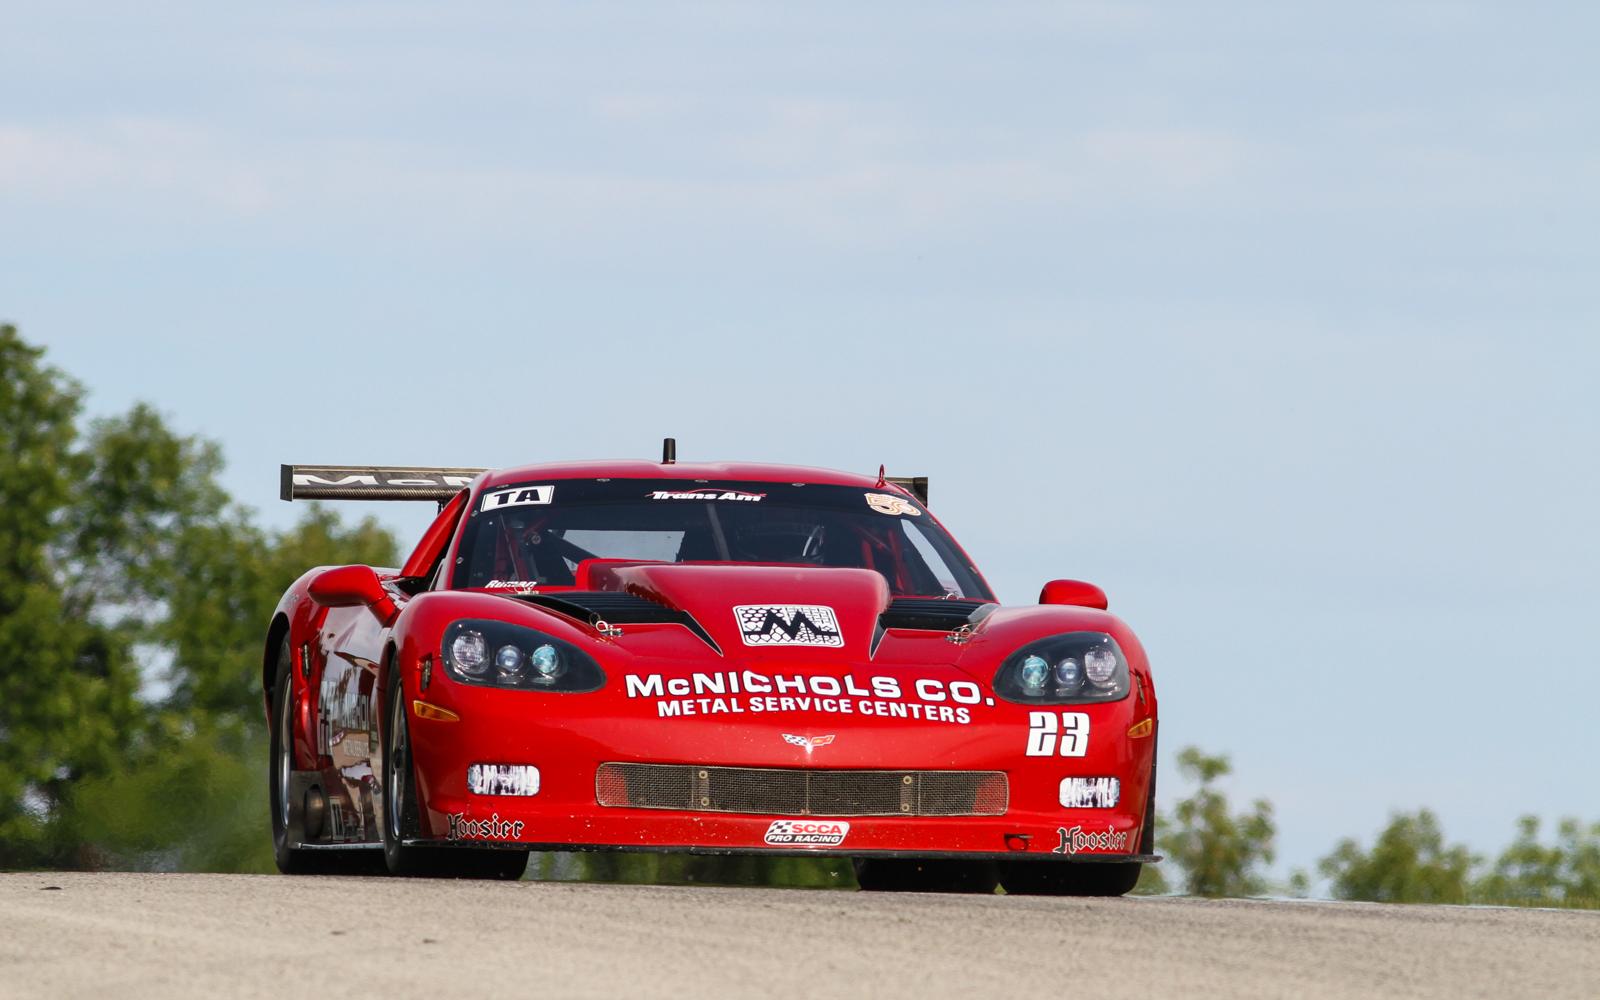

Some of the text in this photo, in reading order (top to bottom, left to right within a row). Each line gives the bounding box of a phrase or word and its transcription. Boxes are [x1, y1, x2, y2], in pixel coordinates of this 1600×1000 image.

[494, 489, 541, 506] TA
[652, 491, 762, 502] Trans Am
[625, 670, 995, 706] McNICHOLS CO.
[658, 696, 971, 724] METAL SERVICE CENTERS
[1025, 711, 1090, 757] 23
[446, 813, 524, 840] Hoosier
[791, 824, 842, 834] SCCA
[794, 836, 840, 844] RACING
[1052, 825, 1127, 854] Hoosier
